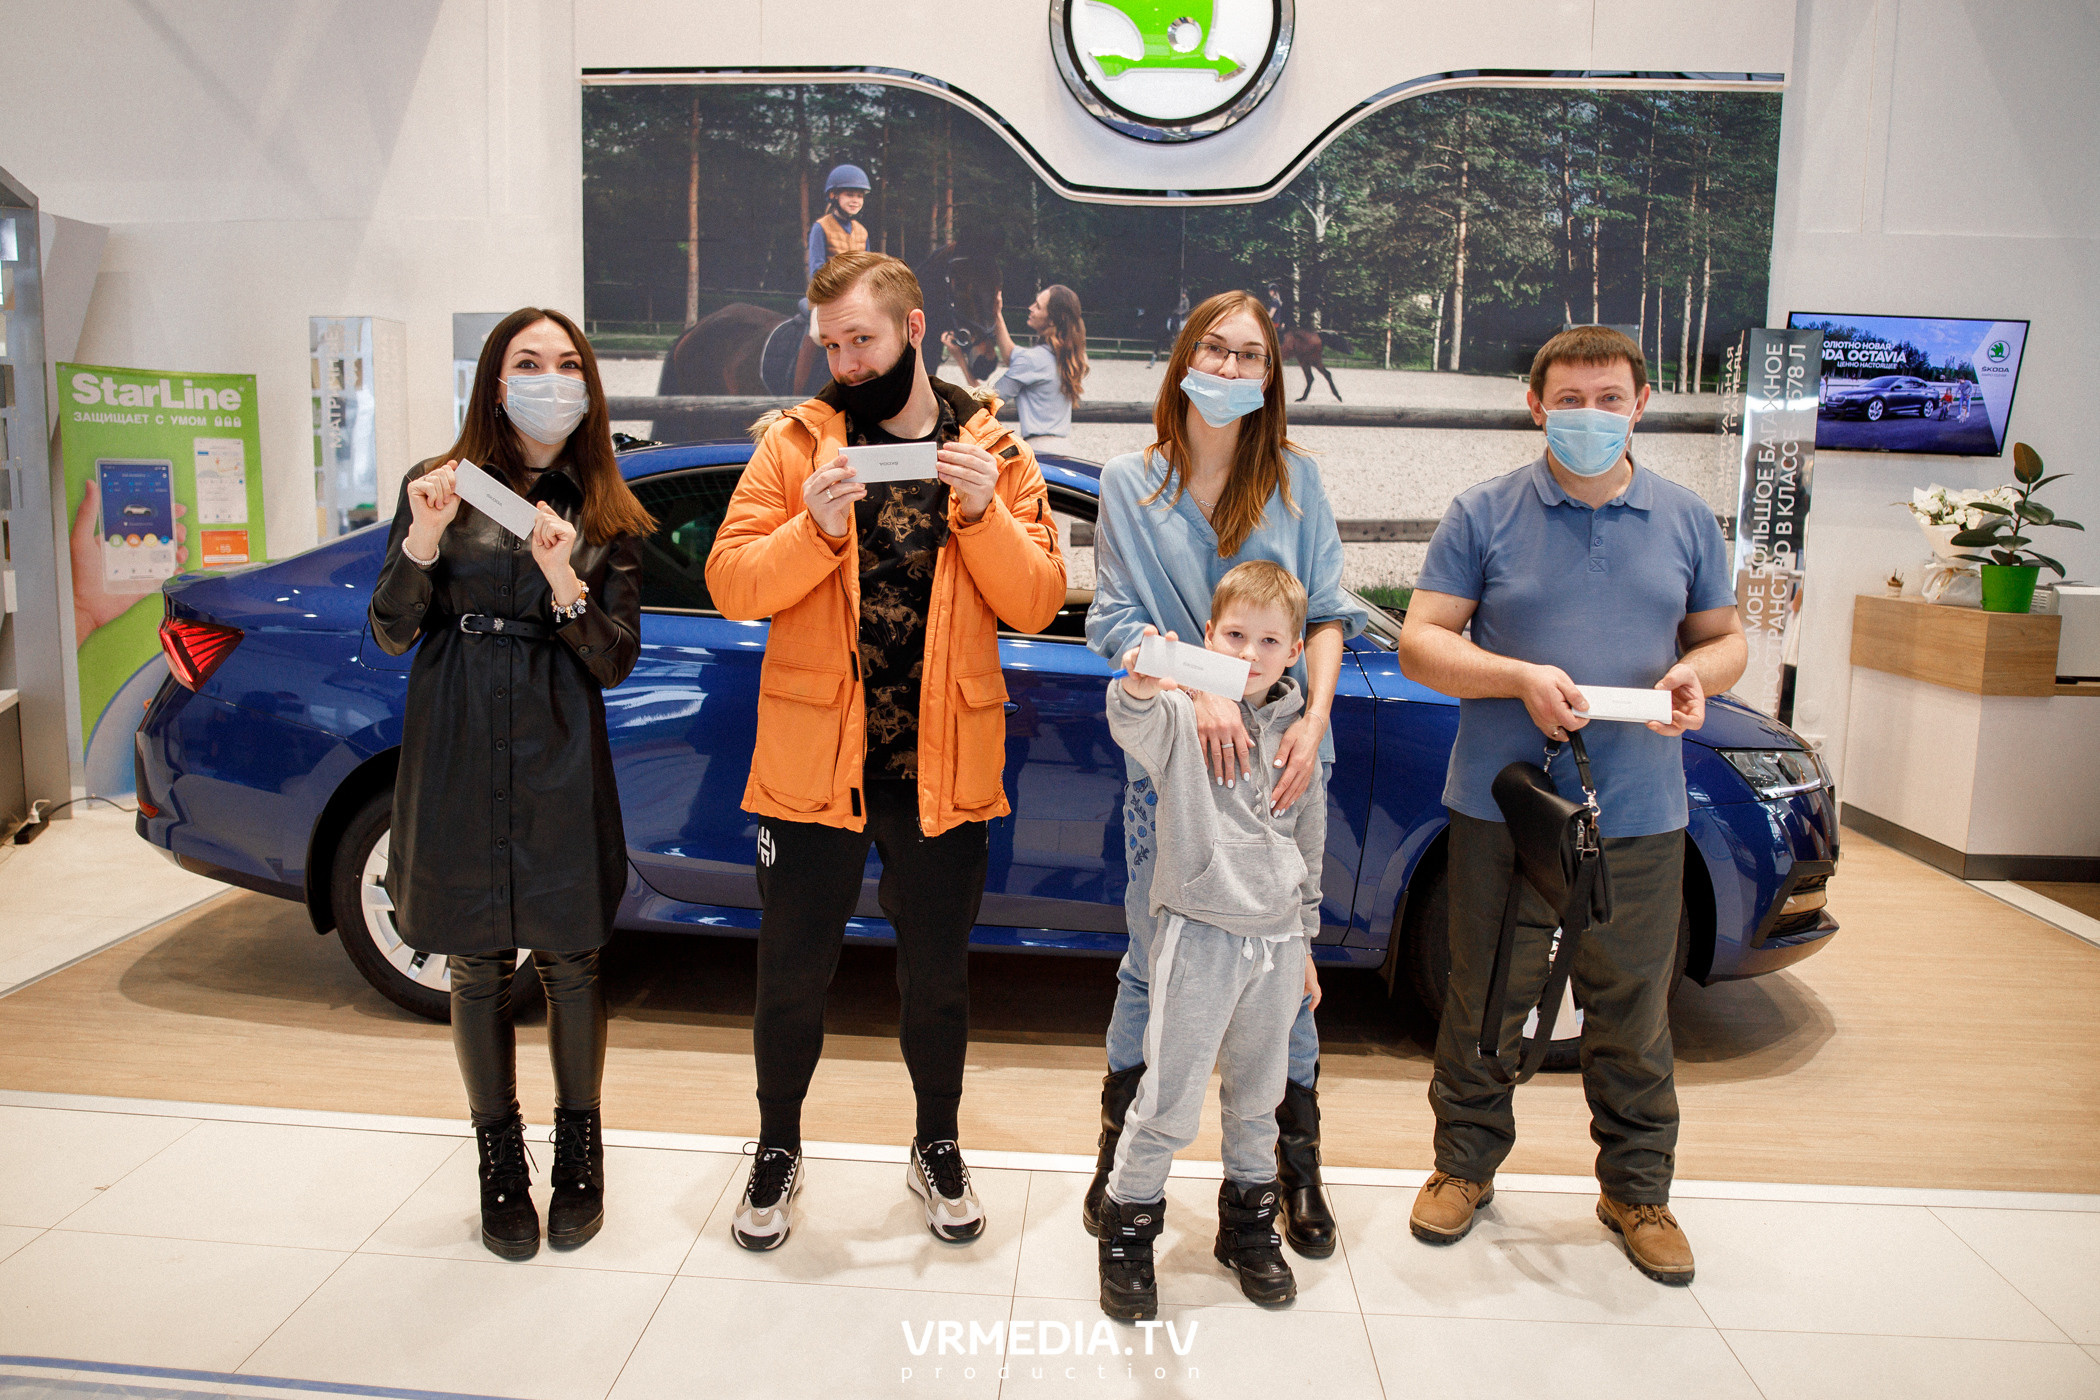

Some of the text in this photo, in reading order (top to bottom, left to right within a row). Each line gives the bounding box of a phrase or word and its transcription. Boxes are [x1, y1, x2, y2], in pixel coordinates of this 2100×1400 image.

[1789, 343, 1807, 362] Л
[1821, 349, 1907, 363] DA OCTAVIA
[1823, 340, 1892, 350] ОЛЮТНО НОВАЯ
[1786, 365, 1805, 400] 578
[1837, 361, 1898, 370] ЦЕННО НАСТОЯЩЕЕ
[72, 373, 242, 411] StarLine
[73, 412, 207, 427] ЗАЩИЩАЕТ С УМОМ
[1717, 346, 1735, 488] ВИРТУАЛЬНАЯ
[1722, 343, 1744, 543] РИБОРНАЯ ПАНЕЛЬ
[1777, 429, 1799, 517] КЛАССЕ
[1746, 342, 1784, 663] САМОЕ БОЛЬШОЕ БАГАЖНОЕ
[1776, 521, 1793, 535] В
[1761, 540, 1791, 713] ПРОСТРАНСТВО
